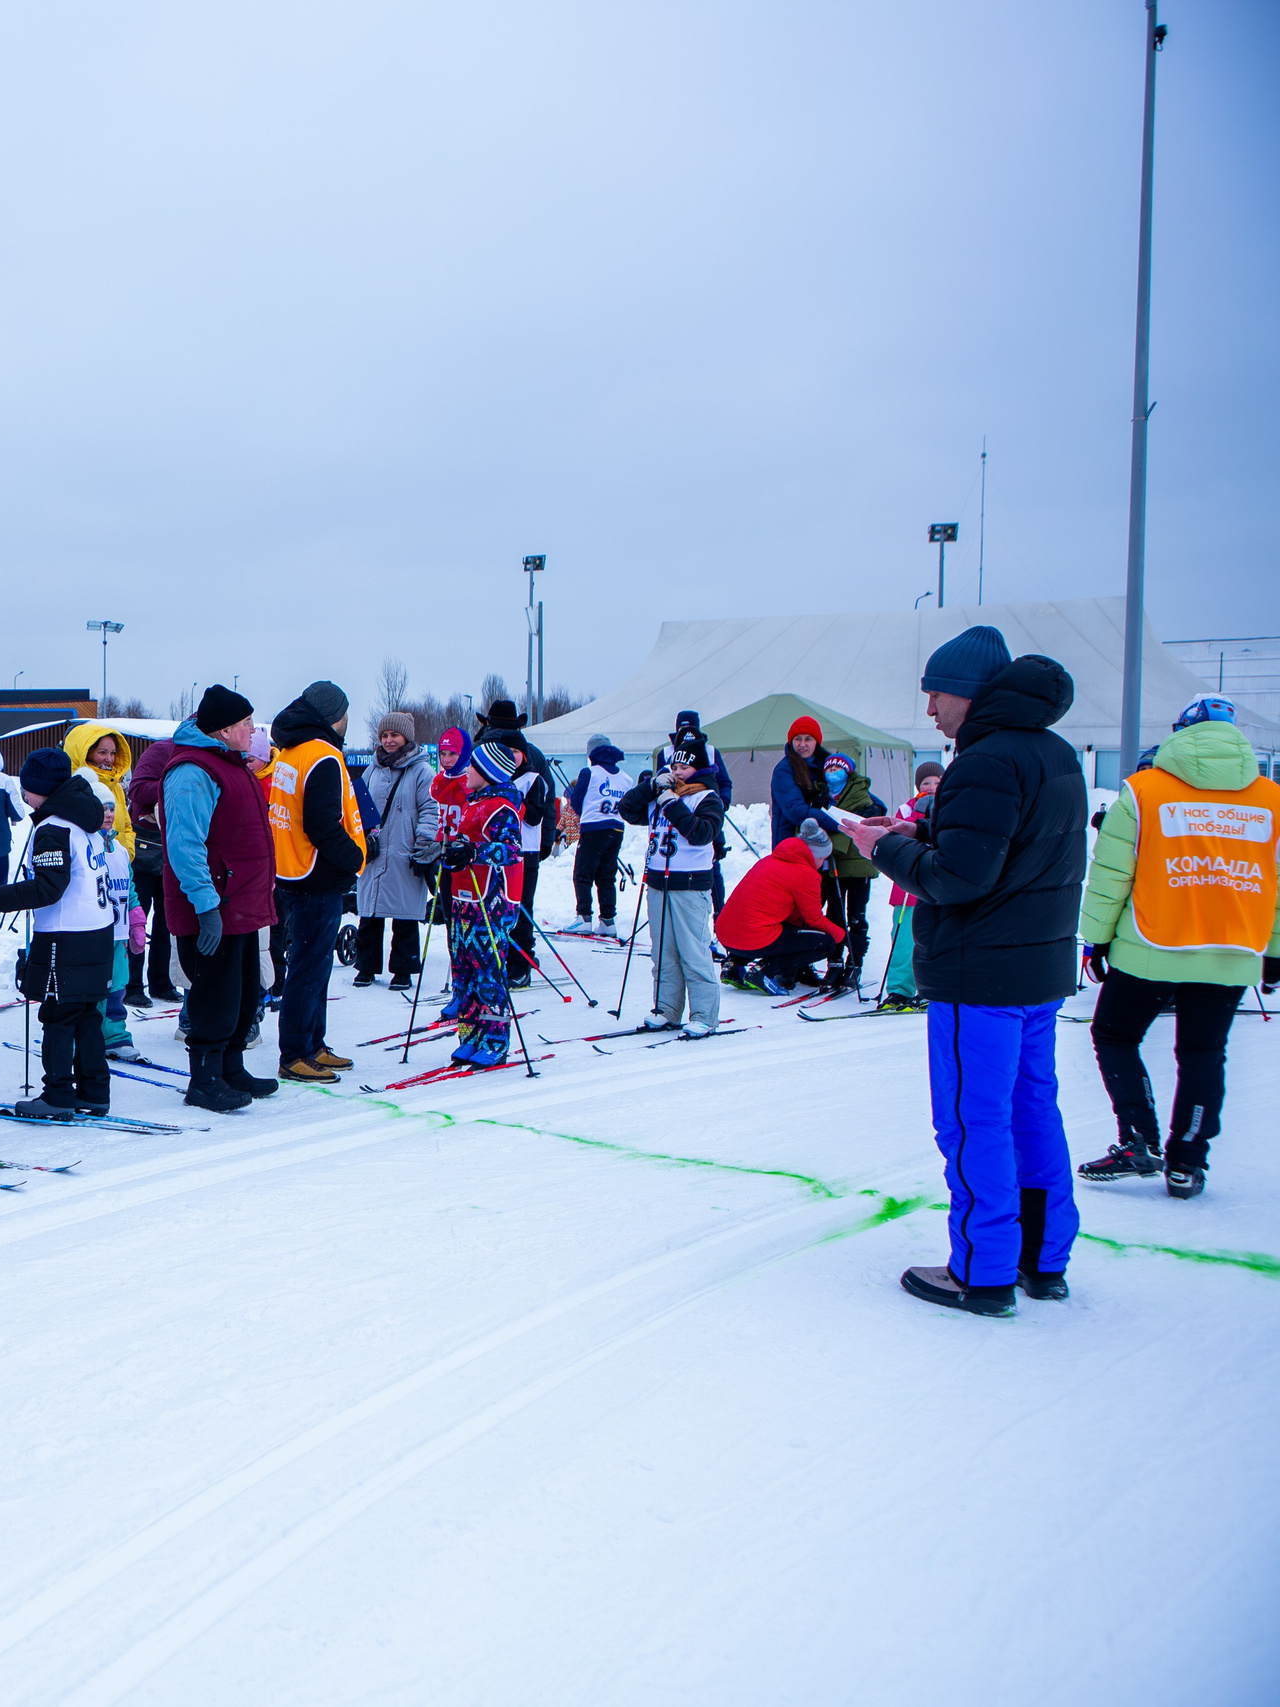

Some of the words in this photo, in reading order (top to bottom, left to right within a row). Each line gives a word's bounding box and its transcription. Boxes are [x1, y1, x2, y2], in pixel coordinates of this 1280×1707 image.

[1167, 805, 1177, 818] У
[1183, 808, 1210, 818] нас
[1217, 808, 1266, 824] общие
[1188, 820, 1246, 836] победы!
[1168, 874, 1262, 894] ОРГАНИЗОРА
